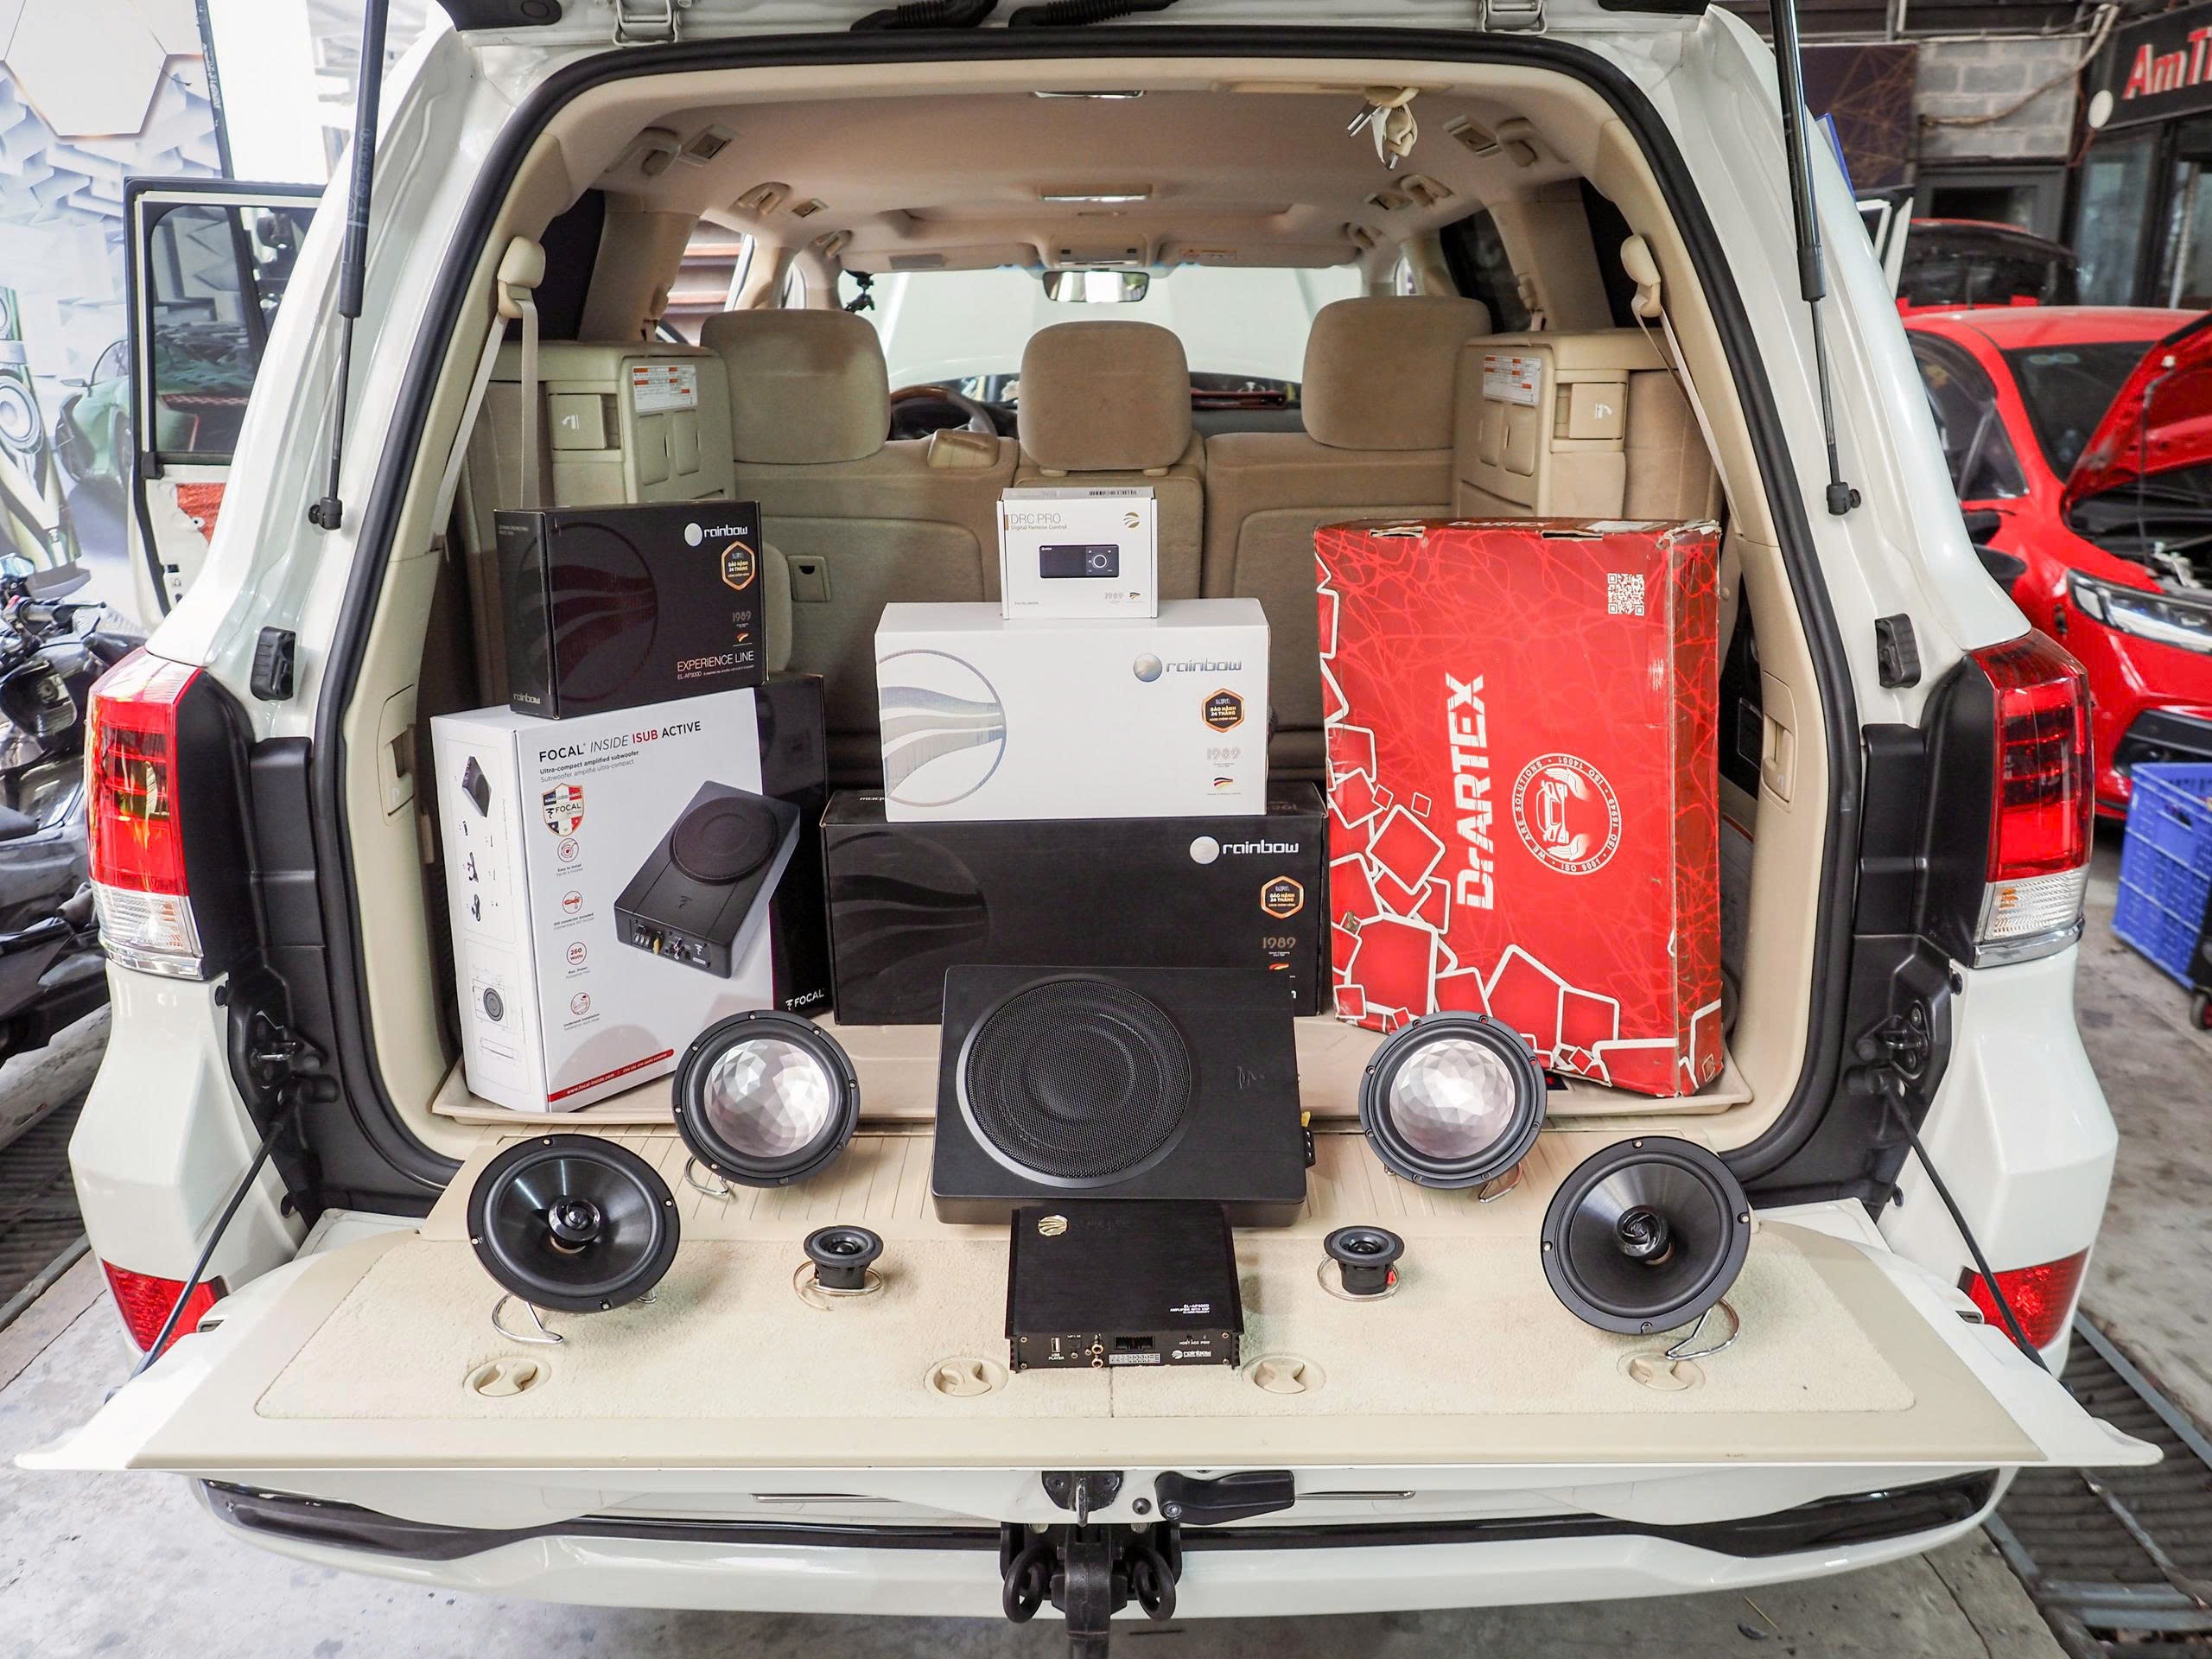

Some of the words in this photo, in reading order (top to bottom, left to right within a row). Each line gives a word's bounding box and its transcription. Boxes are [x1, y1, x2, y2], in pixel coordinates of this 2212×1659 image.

[2121, 27, 2212, 100] AmT
[1011, 513, 1034, 524] DRC
[1038, 513, 1061, 524] PRO
[704, 524, 748, 537] rainbow
[733, 611, 752, 622] 1989
[677, 653, 734, 672] EXPERIENCE
[734, 651, 754, 663] LINE
[1166, 658, 1243, 672] rainbow
[513, 693, 541, 704] rainbow
[590, 734, 629, 753] INSIDE
[632, 729, 658, 744] ISUB
[661, 721, 701, 739] ACTIVE
[1206, 747, 1241, 760] 1989
[539, 762, 582, 775] Ultra-compact
[583, 756, 610, 767] amplified
[611, 750, 639, 761] subwoofer
[1558, 757, 1584, 769] 14001
[540, 771, 573, 783] Subwoofer
[597, 759, 634, 772] ultra-compact
[1588, 769, 1604, 785] ISO
[1514, 760, 1542, 812] SOLUTIONS
[556, 803, 582, 813] FOCAL
[1517, 820, 1530, 841] ARE
[1223, 839, 1299, 855] rainbow
[1607, 834, 1618, 851] ISO
[1532, 846, 1546, 861] WE
[1560, 863, 1577, 872] ISO
[1581, 858, 1600, 871] 9001
[1262, 937, 1296, 949] 1989
[570, 947, 582, 956] 260
[794, 988, 824, 1007] FOCAL
[566, 1072, 615, 1095] www.focal-inside.com
